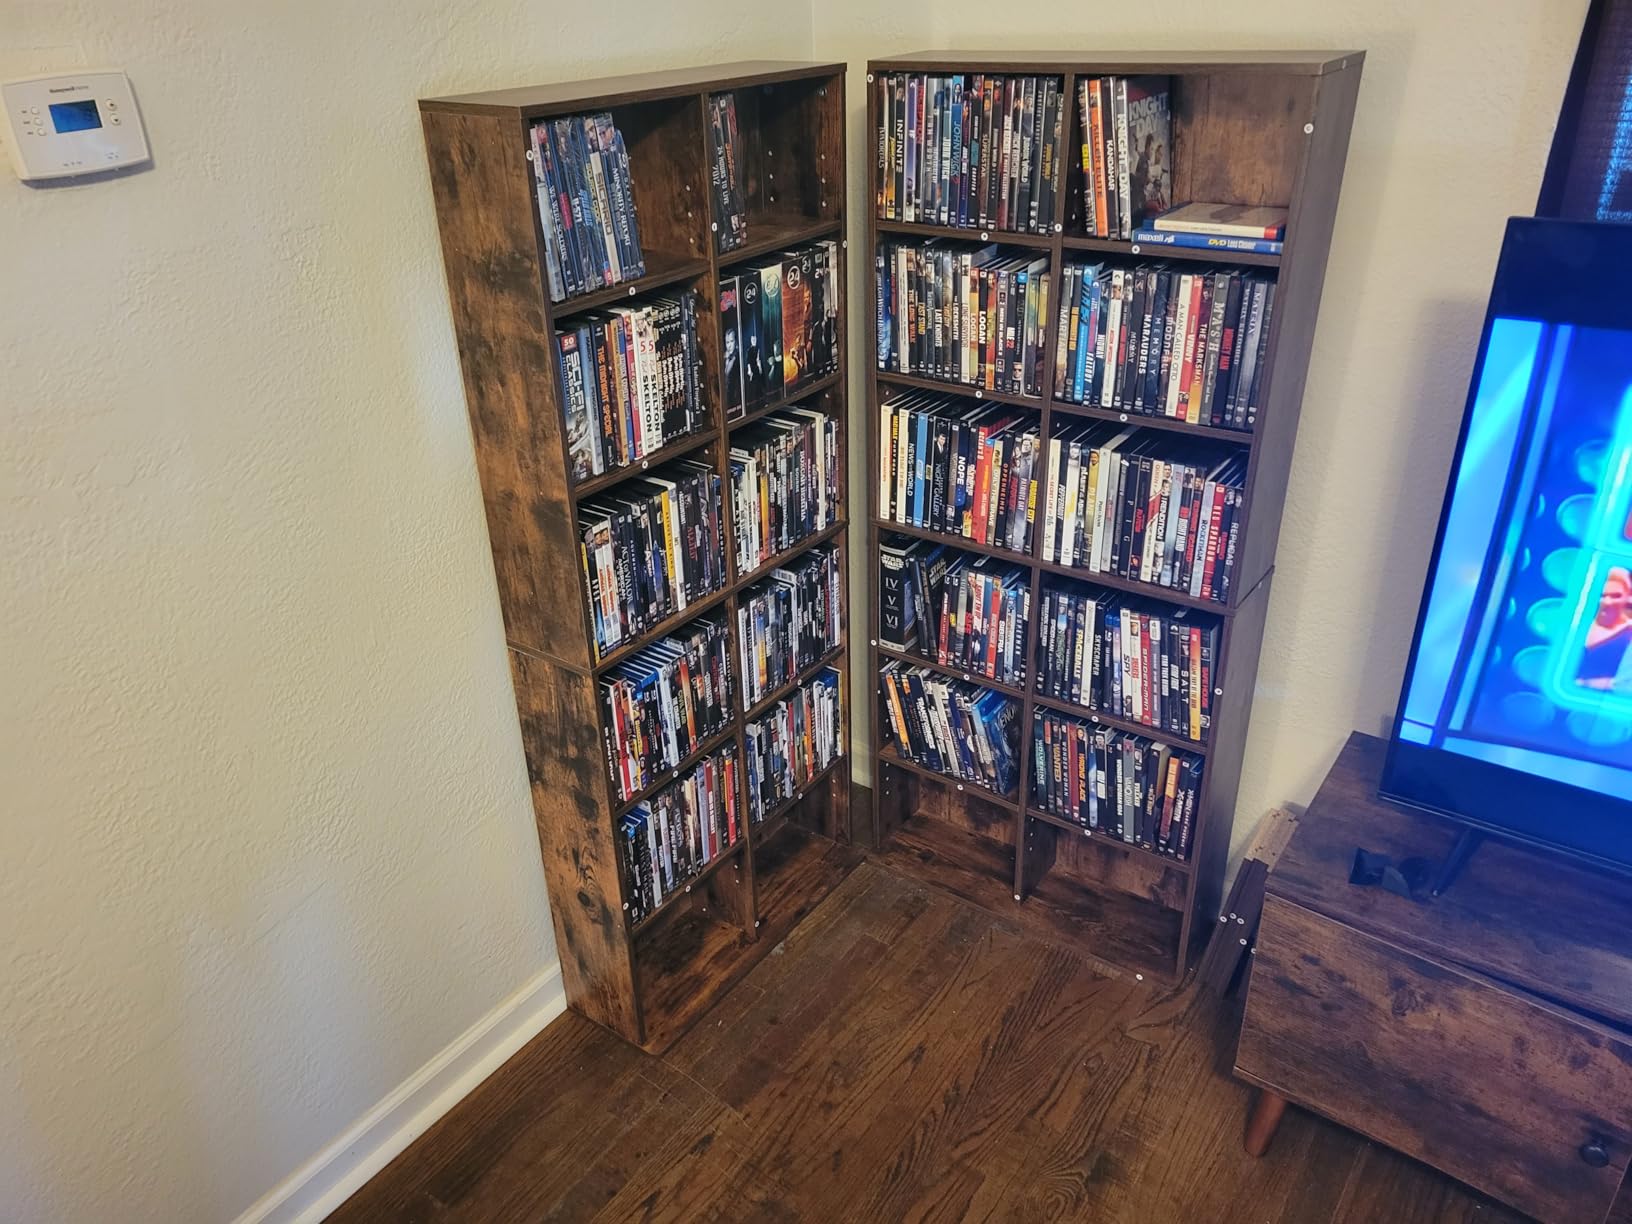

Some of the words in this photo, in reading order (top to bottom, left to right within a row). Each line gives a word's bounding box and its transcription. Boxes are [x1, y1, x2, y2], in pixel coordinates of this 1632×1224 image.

[1129, 93, 1169, 118] KNIGHT
[942, 137, 951, 157] JOHN
[1118, 114, 1127, 164] KNIGHT
[712, 165, 720, 186] 2012
[941, 160, 950, 180] WICK
[951, 151, 959, 176] WICK
[1021, 160, 1029, 182] WORLD
[1107, 140, 1115, 191] KANDAHAR
[1119, 174, 1127, 199] DAY
[592, 200, 601, 224] CODE
[596, 173, 612, 235] SICARIO
[612, 168, 625, 213] MINORITY
[620, 215, 631, 247] REPORT
[1138, 234, 1163, 242] maxell
[789, 270, 799, 283] 24
[747, 288, 756, 299] 24
[1249, 292, 1260, 335] MATRIX
[1096, 334, 1105, 358] MIDWAY
[1128, 331, 1136, 363] MUMMY
[1139, 314, 1151, 374] MARAUDERS
[1150, 317, 1161, 375] MEMORY
[1174, 333, 1182, 360] CALLED
[1199, 324, 1207, 339] THE
[1185, 333, 1194, 363] VINNY
[1194, 341, 1205, 386] MARKSMAN
[570, 352, 584, 409] SCI-FI
[1085, 352, 1093, 383] FALLOUT
[566, 355, 577, 412] CLASSICS
[599, 365, 609, 402] MIDNIGHT
[642, 375, 652, 433] SKELTON
[650, 374, 660, 432] SKELTON
[603, 404, 613, 437] SPECIAL
[957, 456, 965, 485] NOPE
[999, 463, 1008, 515] OPPENHEIMER
[989, 504, 997, 526] BRAVE
[1124, 500, 1133, 542] PIG
[1157, 501, 1167, 540] RENDITION
[1178, 518, 1188, 535] RIGHT
[1212, 505, 1221, 520] RED
[621, 547, 629, 563] ACT
[1175, 535, 1186, 551] HAND
[1196, 520, 1208, 561] ROCKETMAN
[1207, 526, 1218, 561] SPARROW
[1226, 522, 1238, 566] REPLICAS
[885, 577, 899, 589] IV
[929, 558, 946, 577] STAR
[592, 578, 600, 601] APEX
[624, 572, 633, 603] VALOR
[888, 595, 896, 605] V
[886, 614, 898, 626] VI
[1074, 629, 1084, 678] SPACEBALLS
[1093, 634, 1101, 675] SKYSCRAPER
[918, 697, 935, 750] TRANSFORMERS
[1053, 744, 1061, 782] WANTED
[1174, 789, 1184, 822] X-MEN
[673, 808, 682, 847] FLYBOYS
